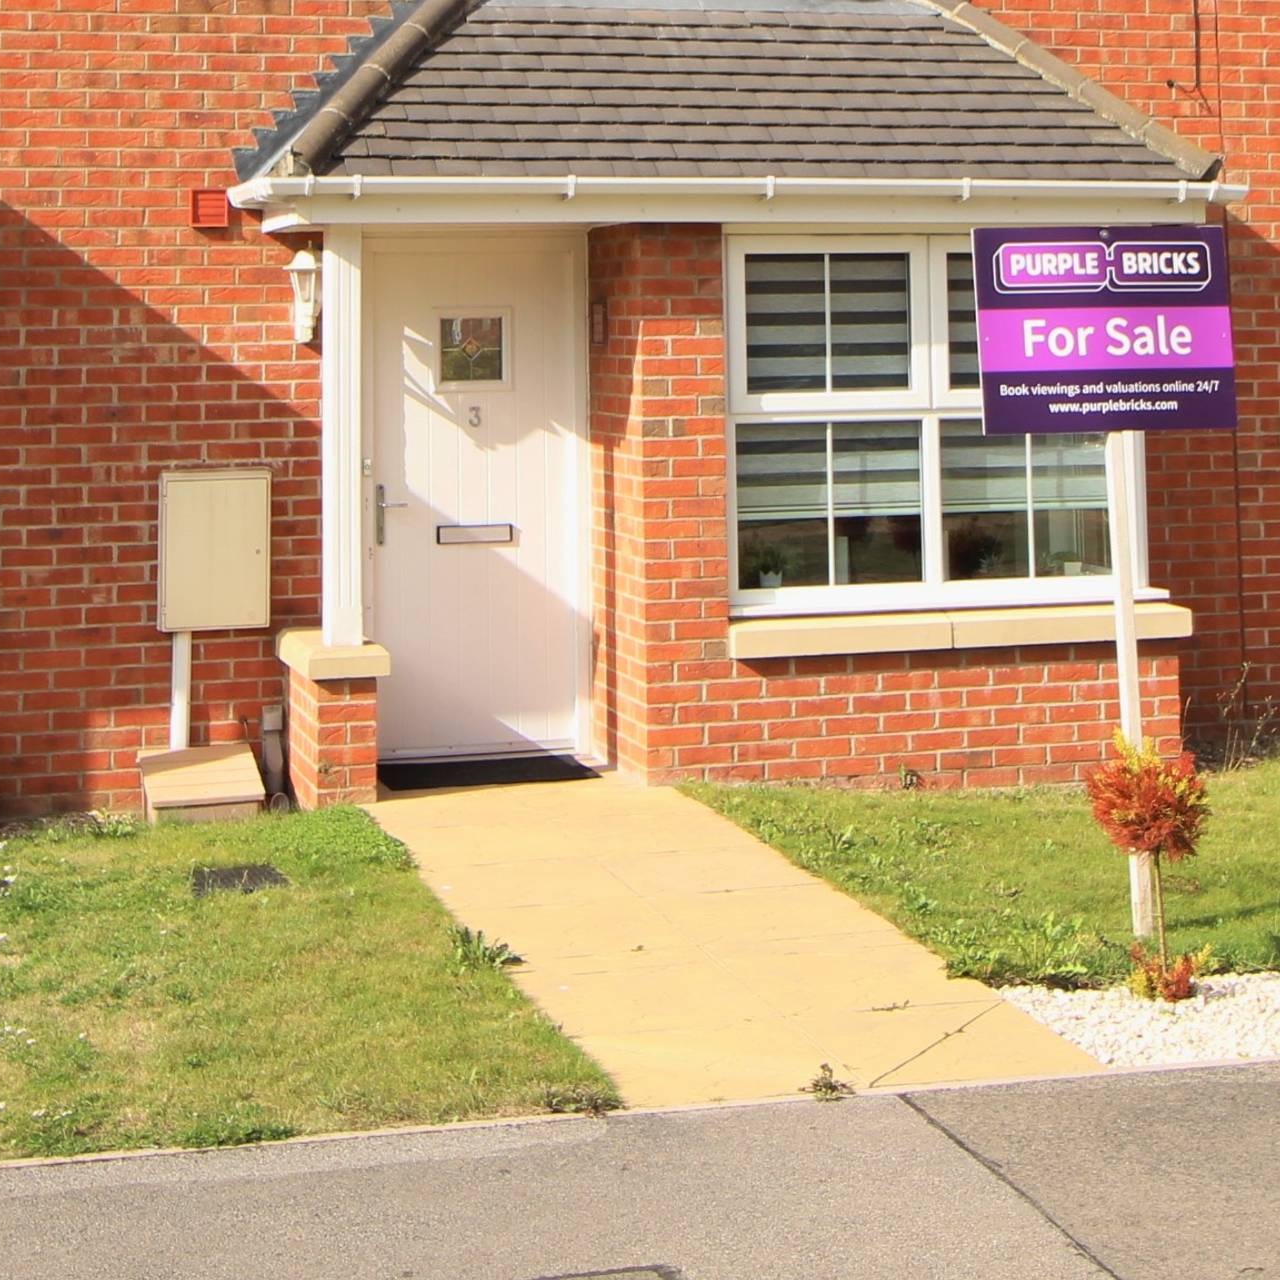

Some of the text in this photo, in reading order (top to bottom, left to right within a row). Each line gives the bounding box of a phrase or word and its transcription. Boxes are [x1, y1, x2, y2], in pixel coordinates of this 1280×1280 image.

[1009, 252, 1201, 276] PURPLE BRICKS
[1022, 314, 1193, 358] For Sale
[999, 379, 1220, 397] Book viewings and valuations online 24/7
[469, 406, 481, 428] 3
[1048, 399, 1178, 415] www.purplebricks.com
